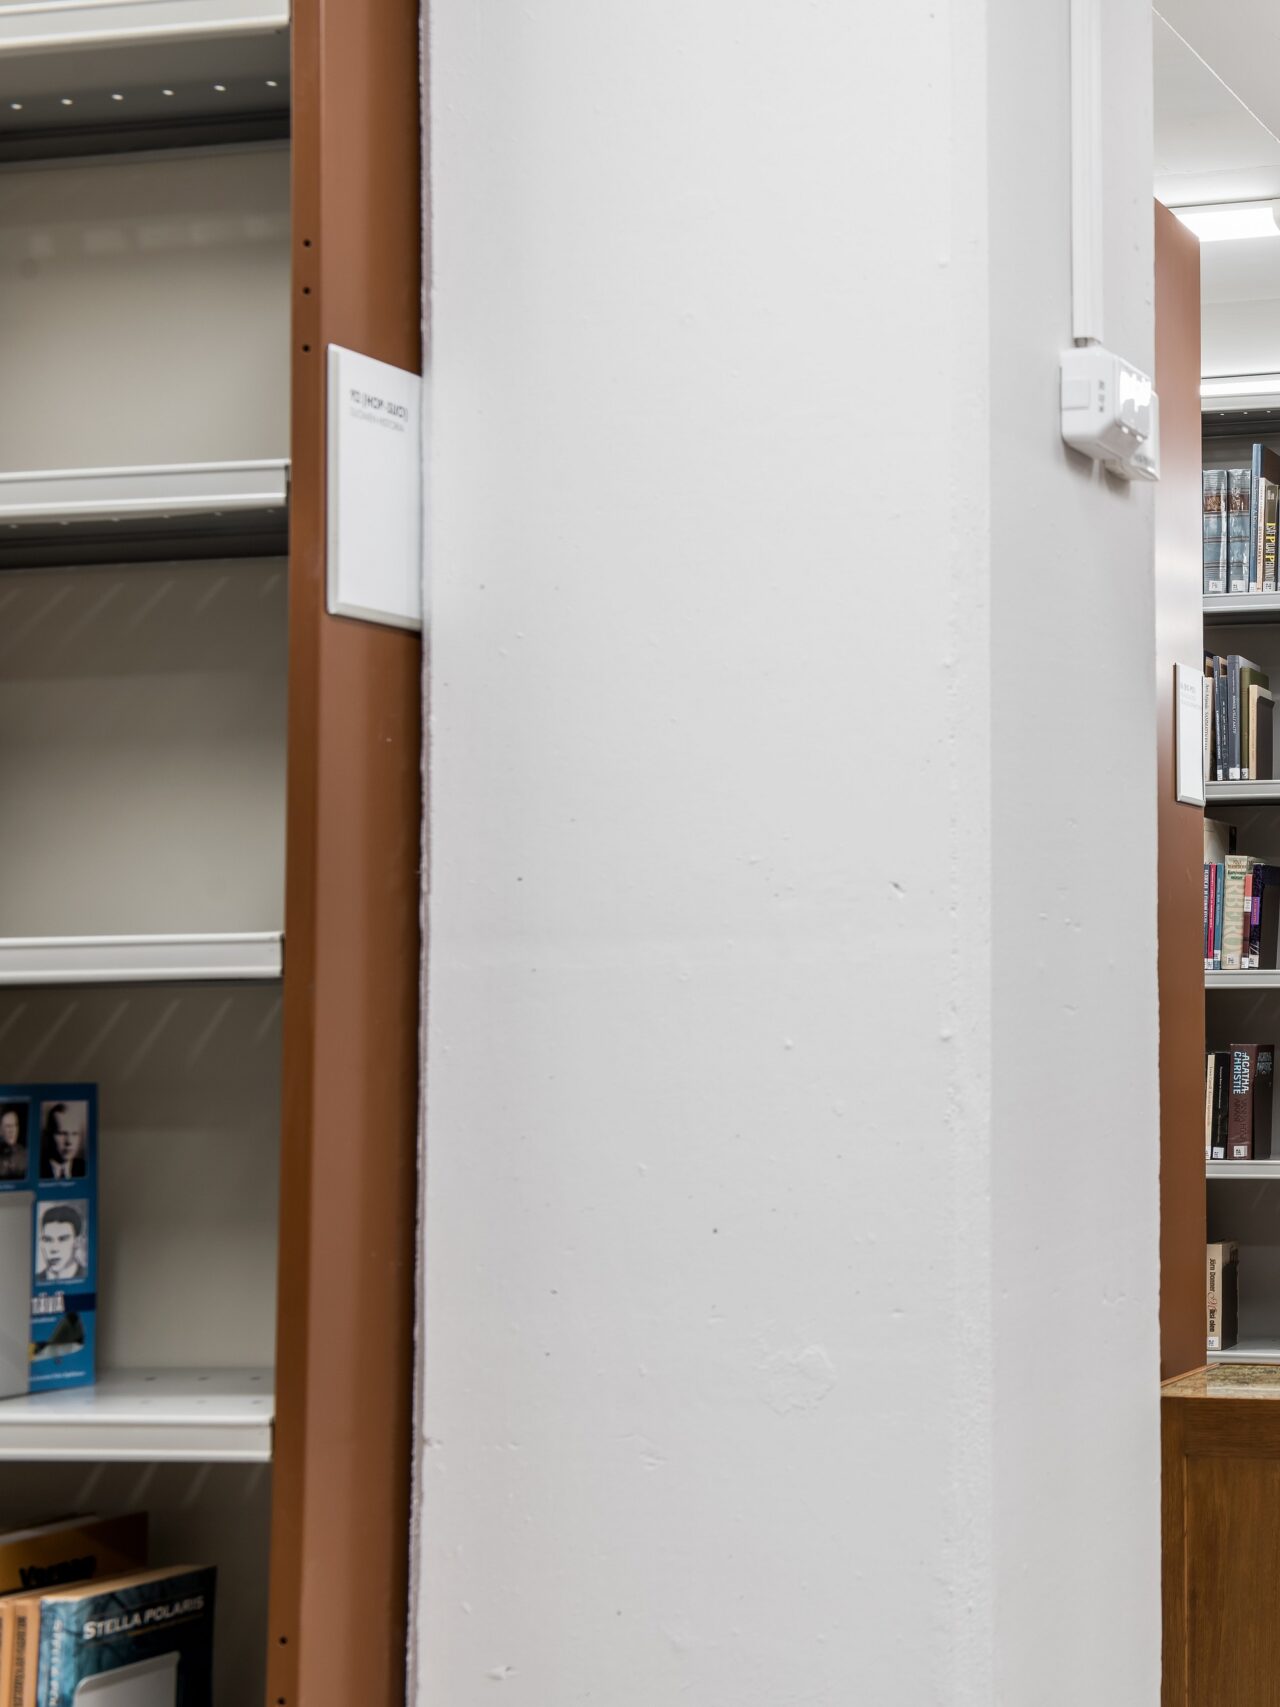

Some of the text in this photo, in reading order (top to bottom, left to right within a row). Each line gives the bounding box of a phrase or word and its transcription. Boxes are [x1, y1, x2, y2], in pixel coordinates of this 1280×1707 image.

[1233, 1052, 1241, 1094] CHRISTIE
[1241, 1052, 1250, 1094] AGATHA
[83, 1595, 205, 1640] STELLA POLARIS
